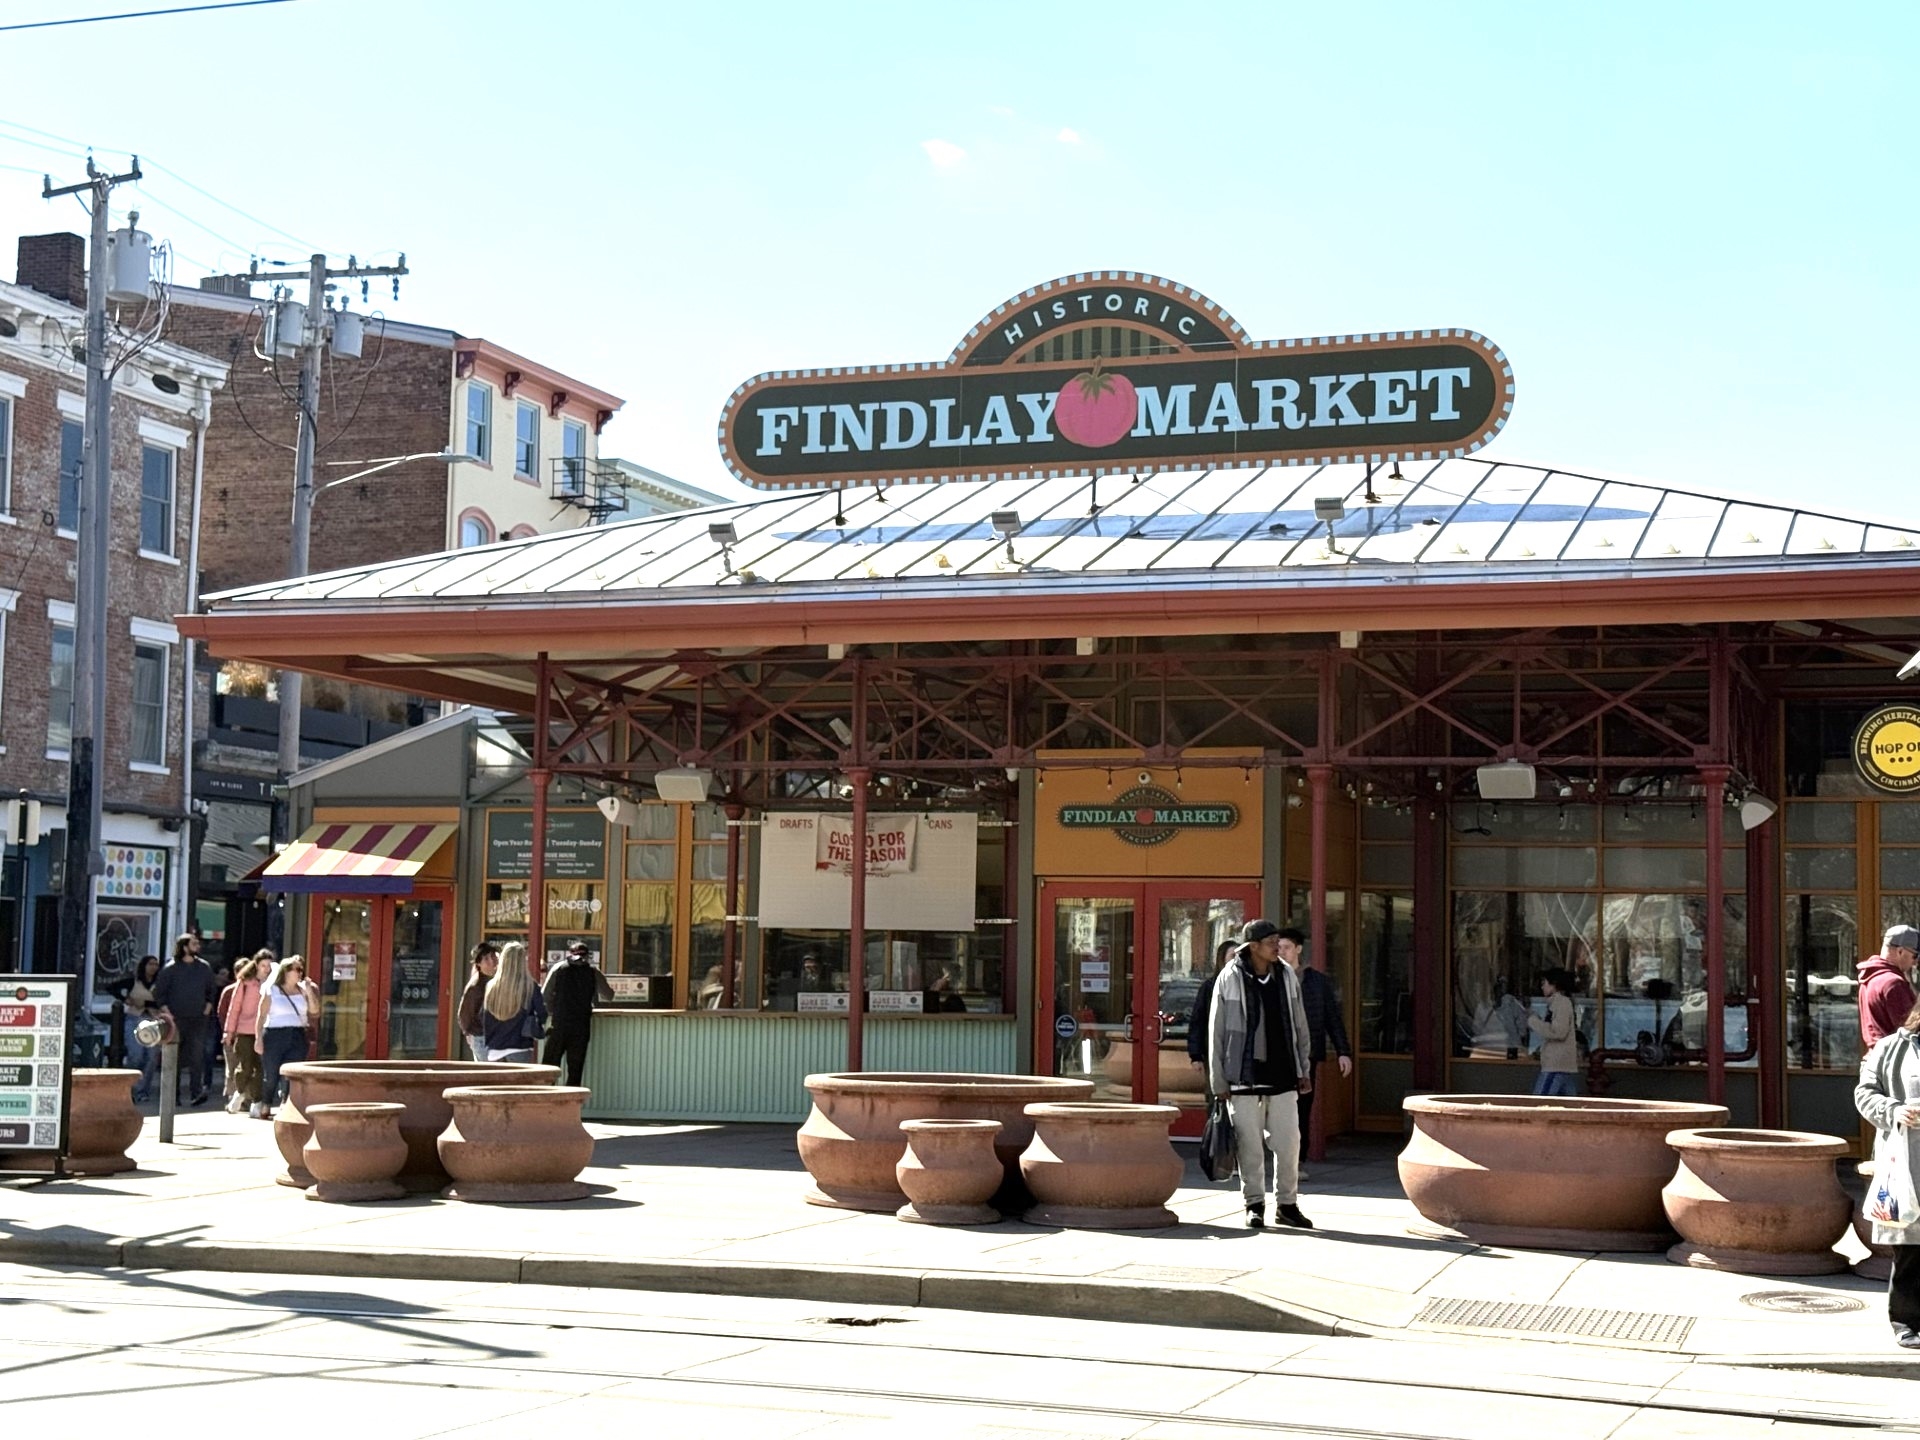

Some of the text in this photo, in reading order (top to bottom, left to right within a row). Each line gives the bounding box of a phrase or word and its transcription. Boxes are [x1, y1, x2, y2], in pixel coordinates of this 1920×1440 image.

[1004, 293, 1196, 345] HISTORIC
[755, 367, 1470, 456] FINDLAY MARKET
[1875, 743, 1904, 755] HOP
[1063, 810, 1230, 823] FINDLAY MARKET
[780, 818, 813, 829] DRAFTS
[928, 819, 953, 829] CANS
[493, 839, 509, 847] Open
[830, 831, 905, 847] CLOD FOR
[828, 846, 906, 862] THE EASON
[0, 1008, 26, 1016] RKET
